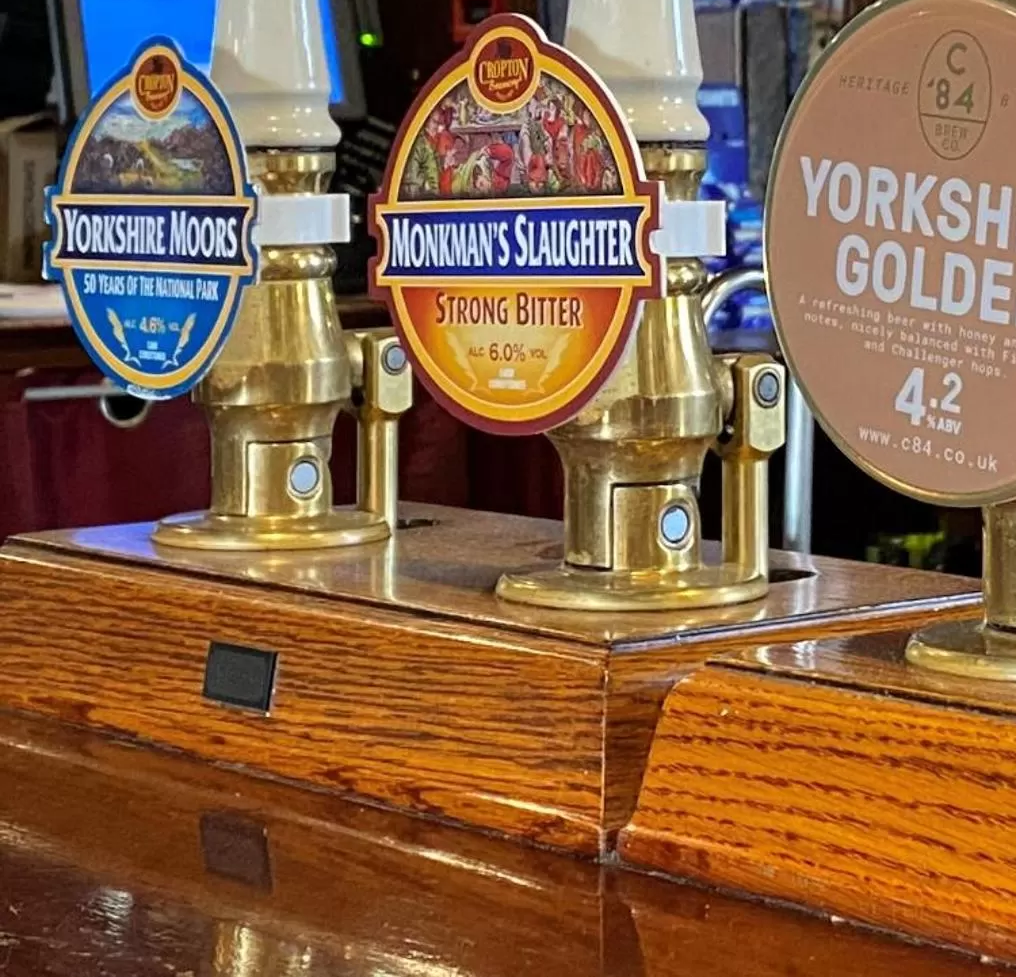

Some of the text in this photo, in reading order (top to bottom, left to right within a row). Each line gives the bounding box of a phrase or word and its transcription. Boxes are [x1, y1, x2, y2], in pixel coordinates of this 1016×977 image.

[479, 58, 529, 84] CROPTON
[946, 42, 967, 75] C
[839, 75, 909, 96] HERITAGE
[934, 124, 969, 140] BREW
[63, 208, 166, 255] YORKSHIRE
[169, 210, 238, 258] MOORS
[391, 214, 634, 268] MONKMAN'S SLAUGHTER
[83, 273, 219, 301] 50 YEARS OF THE NATIONAL PARK
[435, 291, 582, 327] STRONG BITTER
[799, 293, 806, 305] A
[812, 297, 881, 323] refreshing
[887, 309, 916, 328] beer
[922, 320, 952, 336] with
[960, 325, 996, 345] honey
[489, 342, 526, 362] 6.0%
[851, 321, 894, 340] nicely
[900, 330, 959, 353] balanced
[965, 343, 996, 361] with
[863, 339, 886, 353] and
[891, 343, 964, 368] Challenger
[895, 367, 963, 426] 4.2
[926, 413, 963, 436] %ABV
[858, 426, 998, 473] www.c84.co.uk
